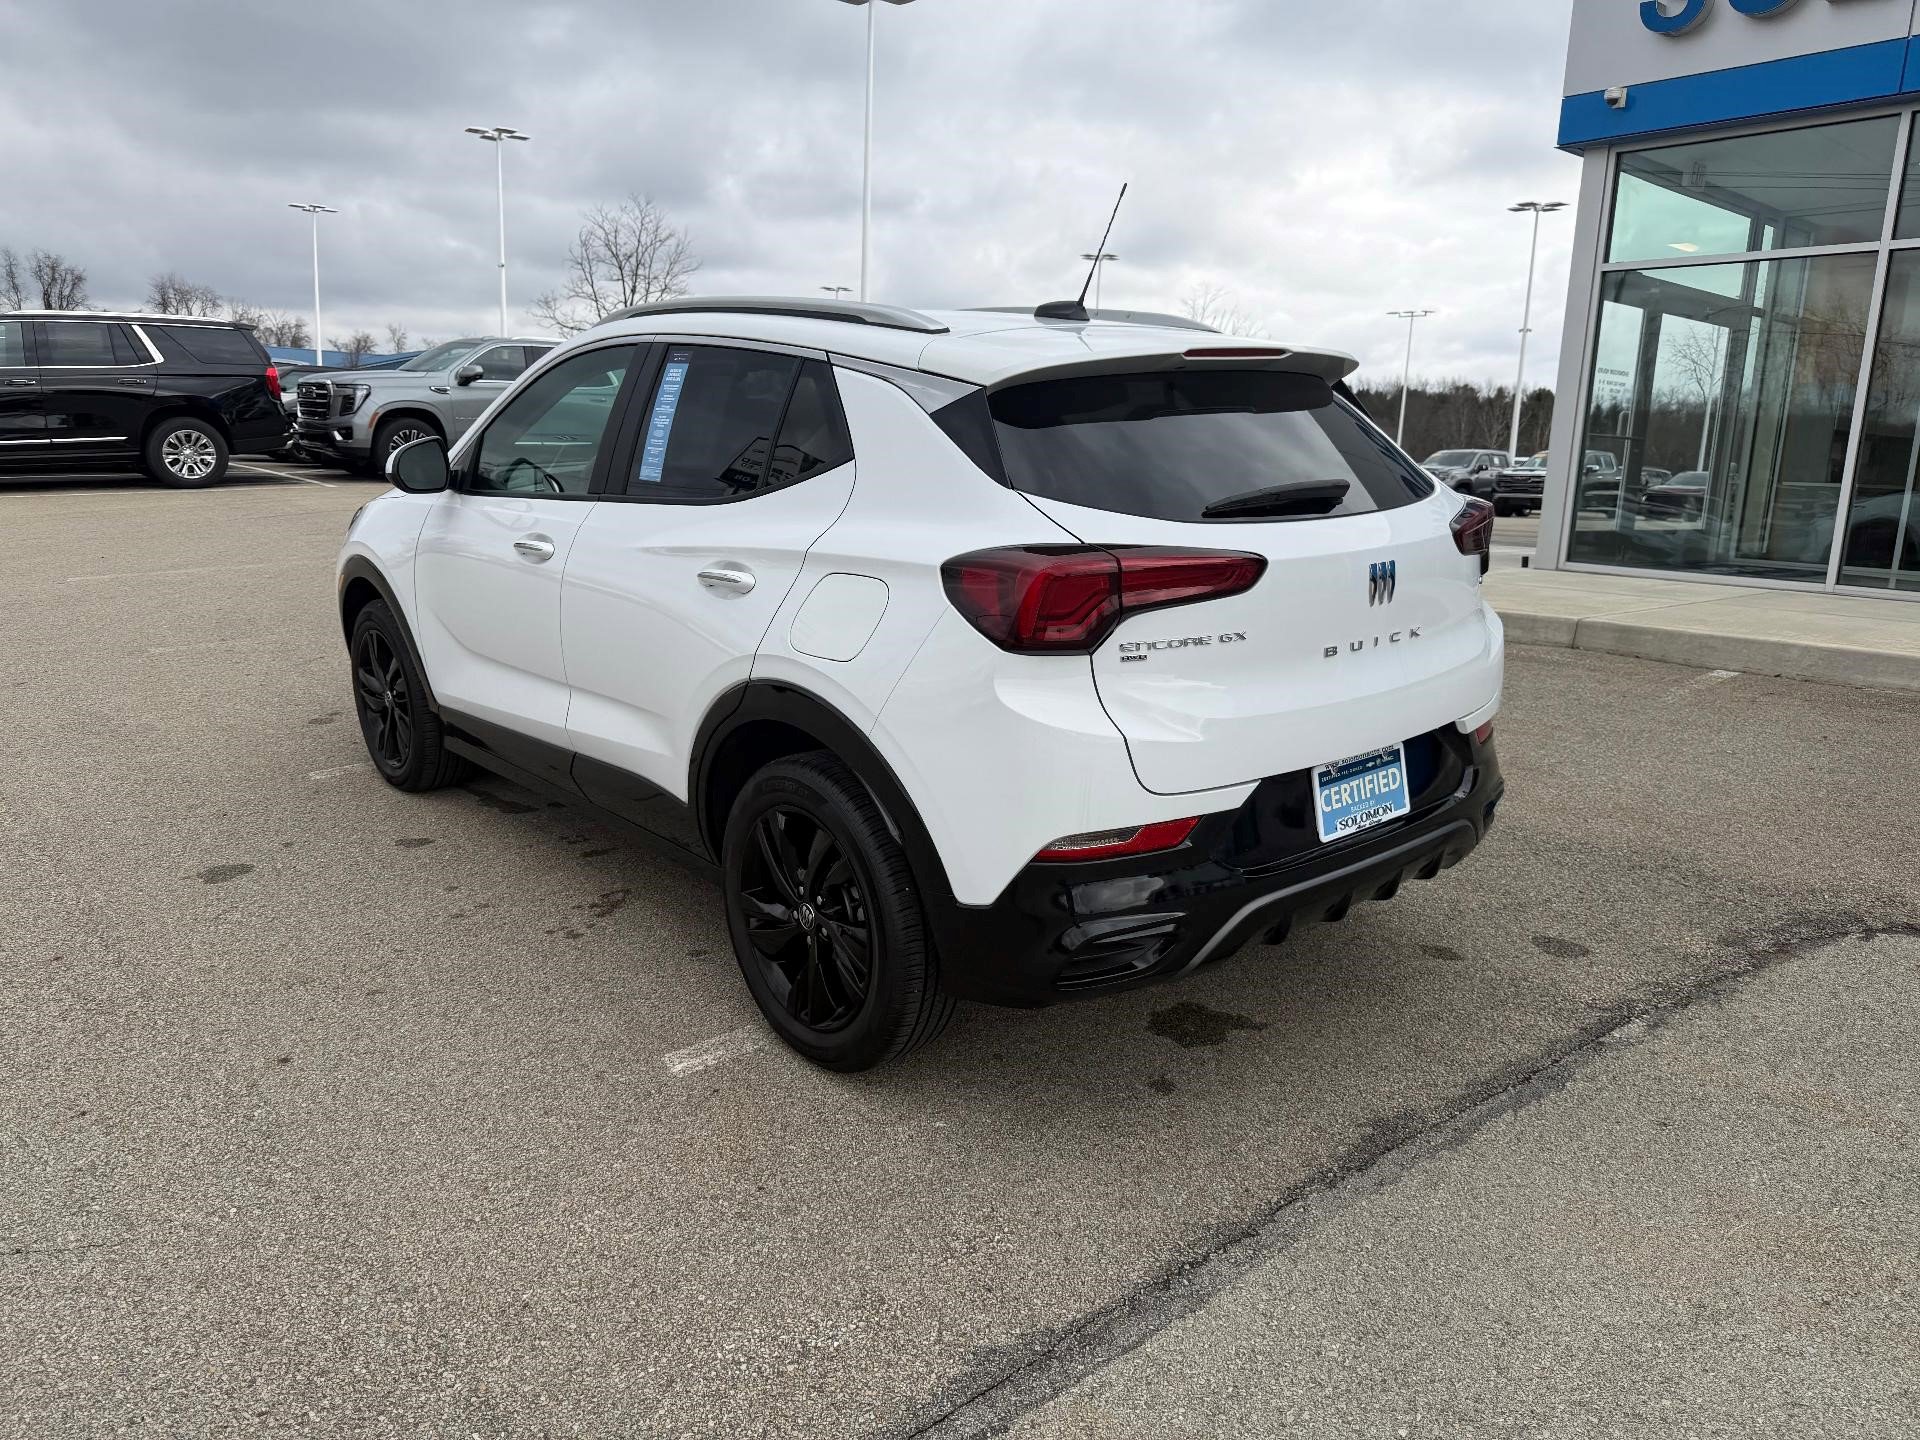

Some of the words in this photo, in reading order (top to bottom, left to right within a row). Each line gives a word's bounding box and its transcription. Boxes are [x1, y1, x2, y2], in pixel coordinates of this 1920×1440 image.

[1119, 635, 1213, 653] ENCORE
[1218, 630, 1248, 643] GX
[1323, 626, 1422, 658] BUICK
[1320, 767, 1401, 812] CERTIFIED
[1338, 802, 1393, 831] SOLOMON
